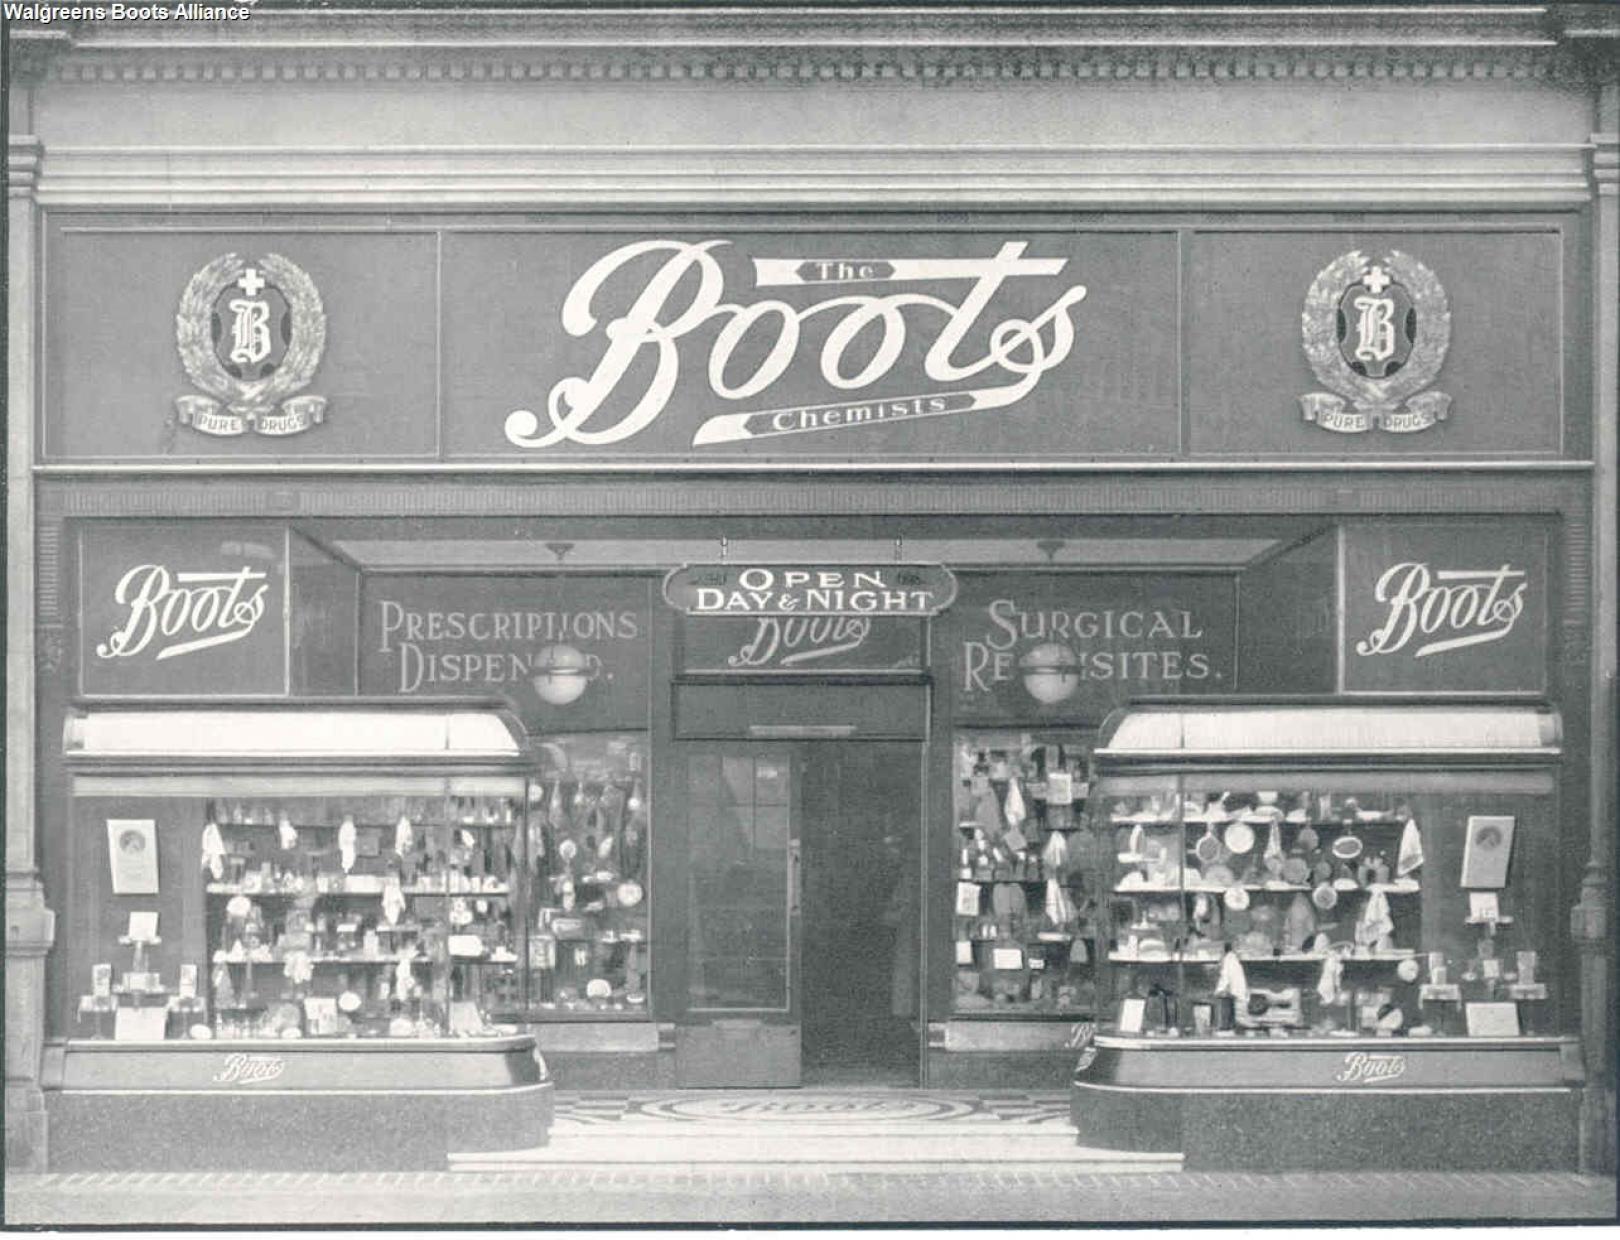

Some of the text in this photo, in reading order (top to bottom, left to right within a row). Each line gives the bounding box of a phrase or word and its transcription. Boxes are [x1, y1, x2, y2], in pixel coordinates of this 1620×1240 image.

[815, 261, 875, 280] The
[228, 298, 271, 363] B
[504, 240, 1087, 448] Boots
[1353, 297, 1395, 361] B
[772, 394, 946, 432] Chemists
[697, 588, 934, 612] DAY & NIGHT
[739, 568, 886, 591] OPEN
[96, 564, 269, 661] Boots
[379, 601, 638, 652] PRESCRIPTIONS
[986, 599, 1203, 650] SURGICAL
[1356, 562, 1528, 658] Boots
[399, 642, 615, 694] DISPEND.
[963, 641, 1223, 692] REISITES.
[213, 1053, 285, 1085] Boots
[1336, 1052, 1405, 1083] Boots
